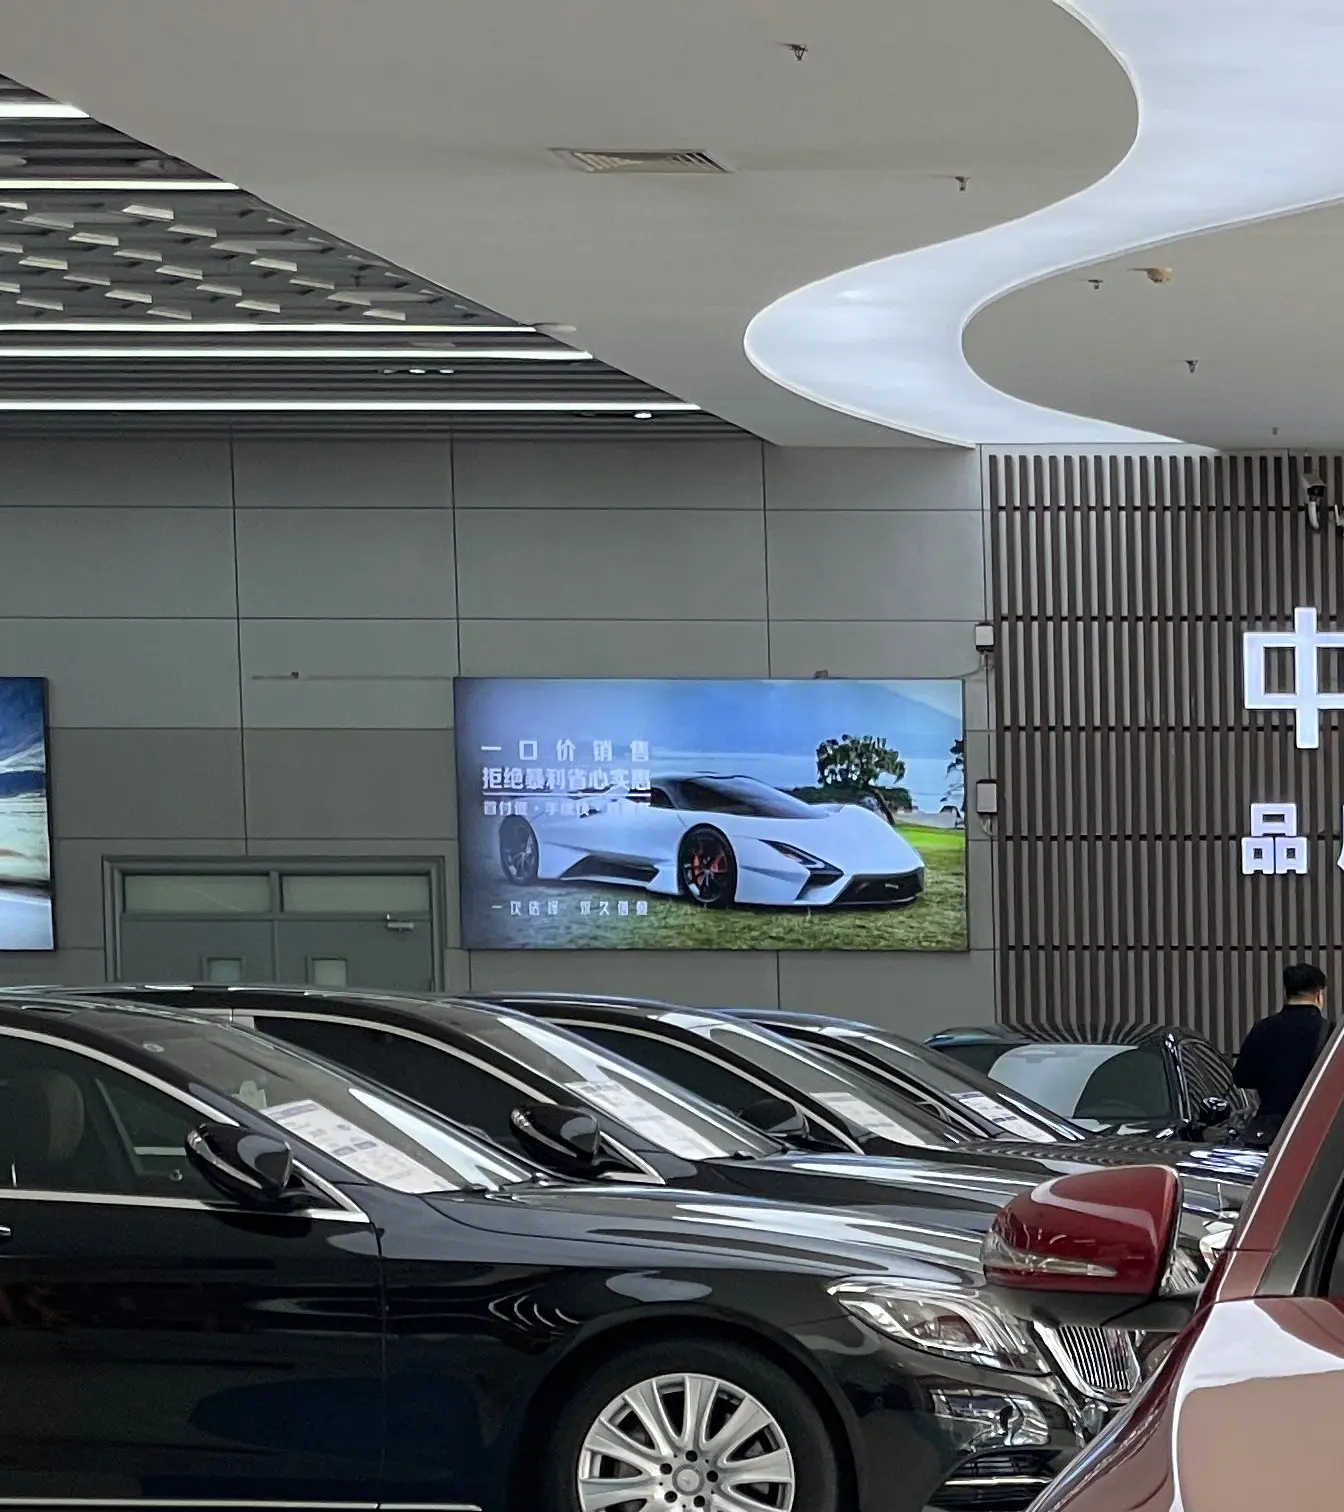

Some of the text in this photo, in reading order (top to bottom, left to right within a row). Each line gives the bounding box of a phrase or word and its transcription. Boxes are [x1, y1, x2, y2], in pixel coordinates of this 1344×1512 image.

[481, 739, 649, 762] 一口价销售
